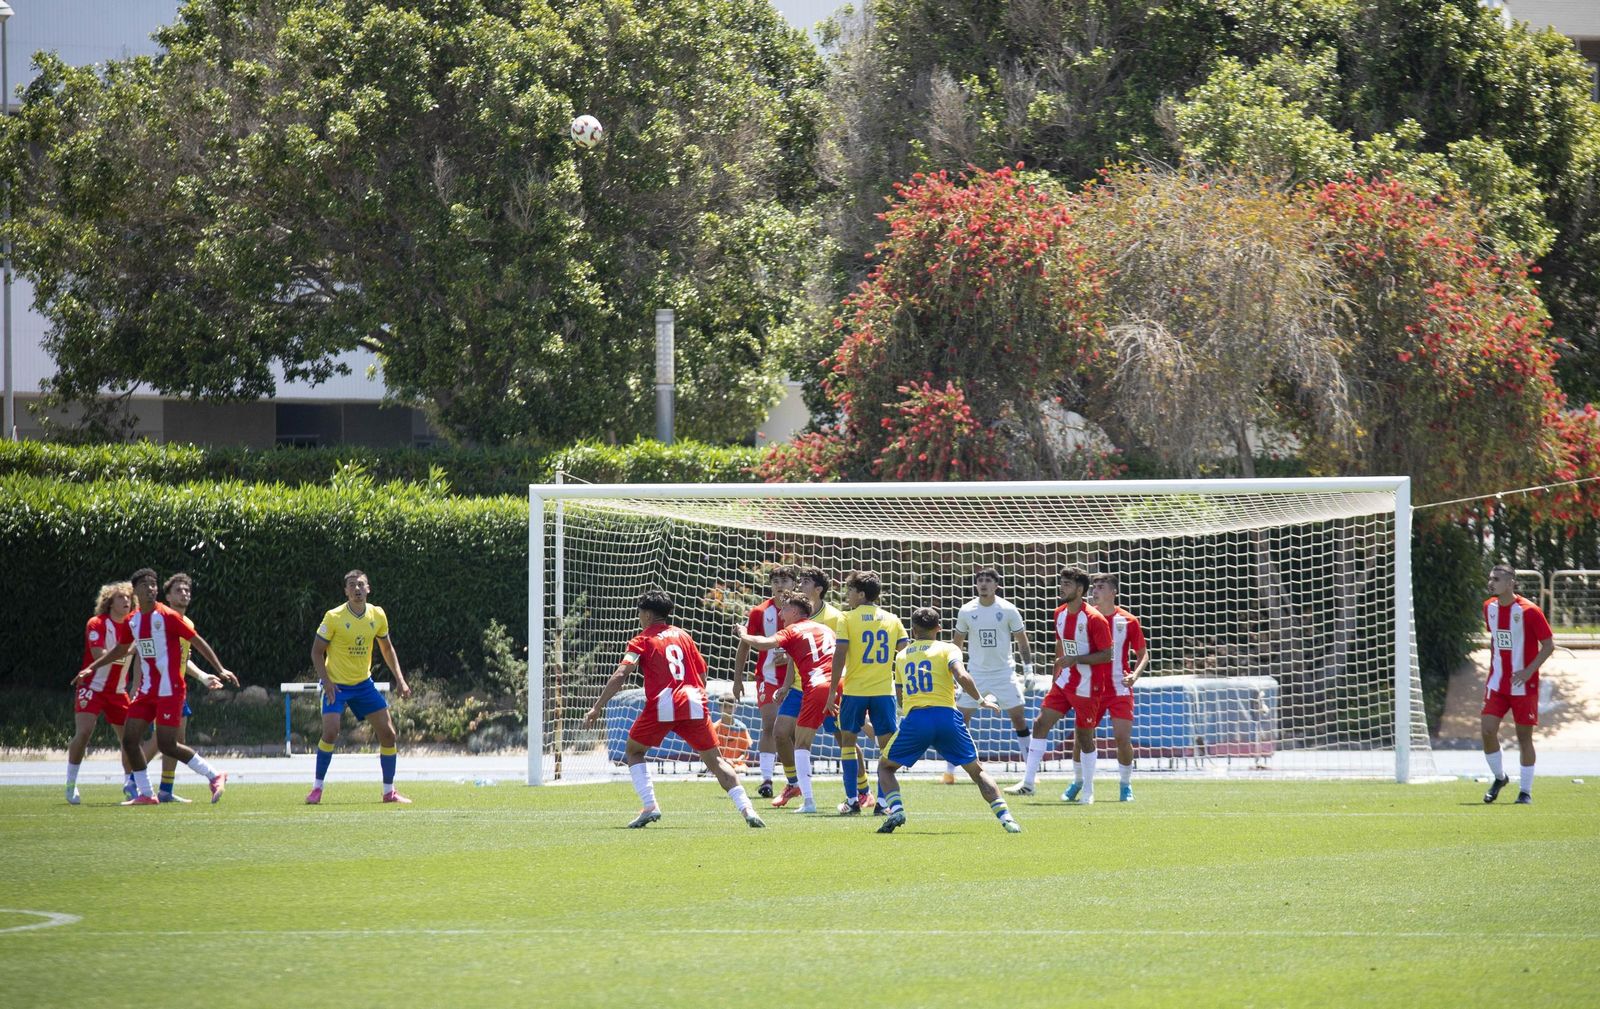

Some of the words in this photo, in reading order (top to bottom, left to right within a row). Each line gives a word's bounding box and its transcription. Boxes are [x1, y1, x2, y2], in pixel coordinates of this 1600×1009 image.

[665, 644, 685, 681] 8
[802, 630, 836, 663] 14
[862, 629, 889, 664] 23
[79, 687, 93, 700] 24
[905, 660, 933, 695] 36
